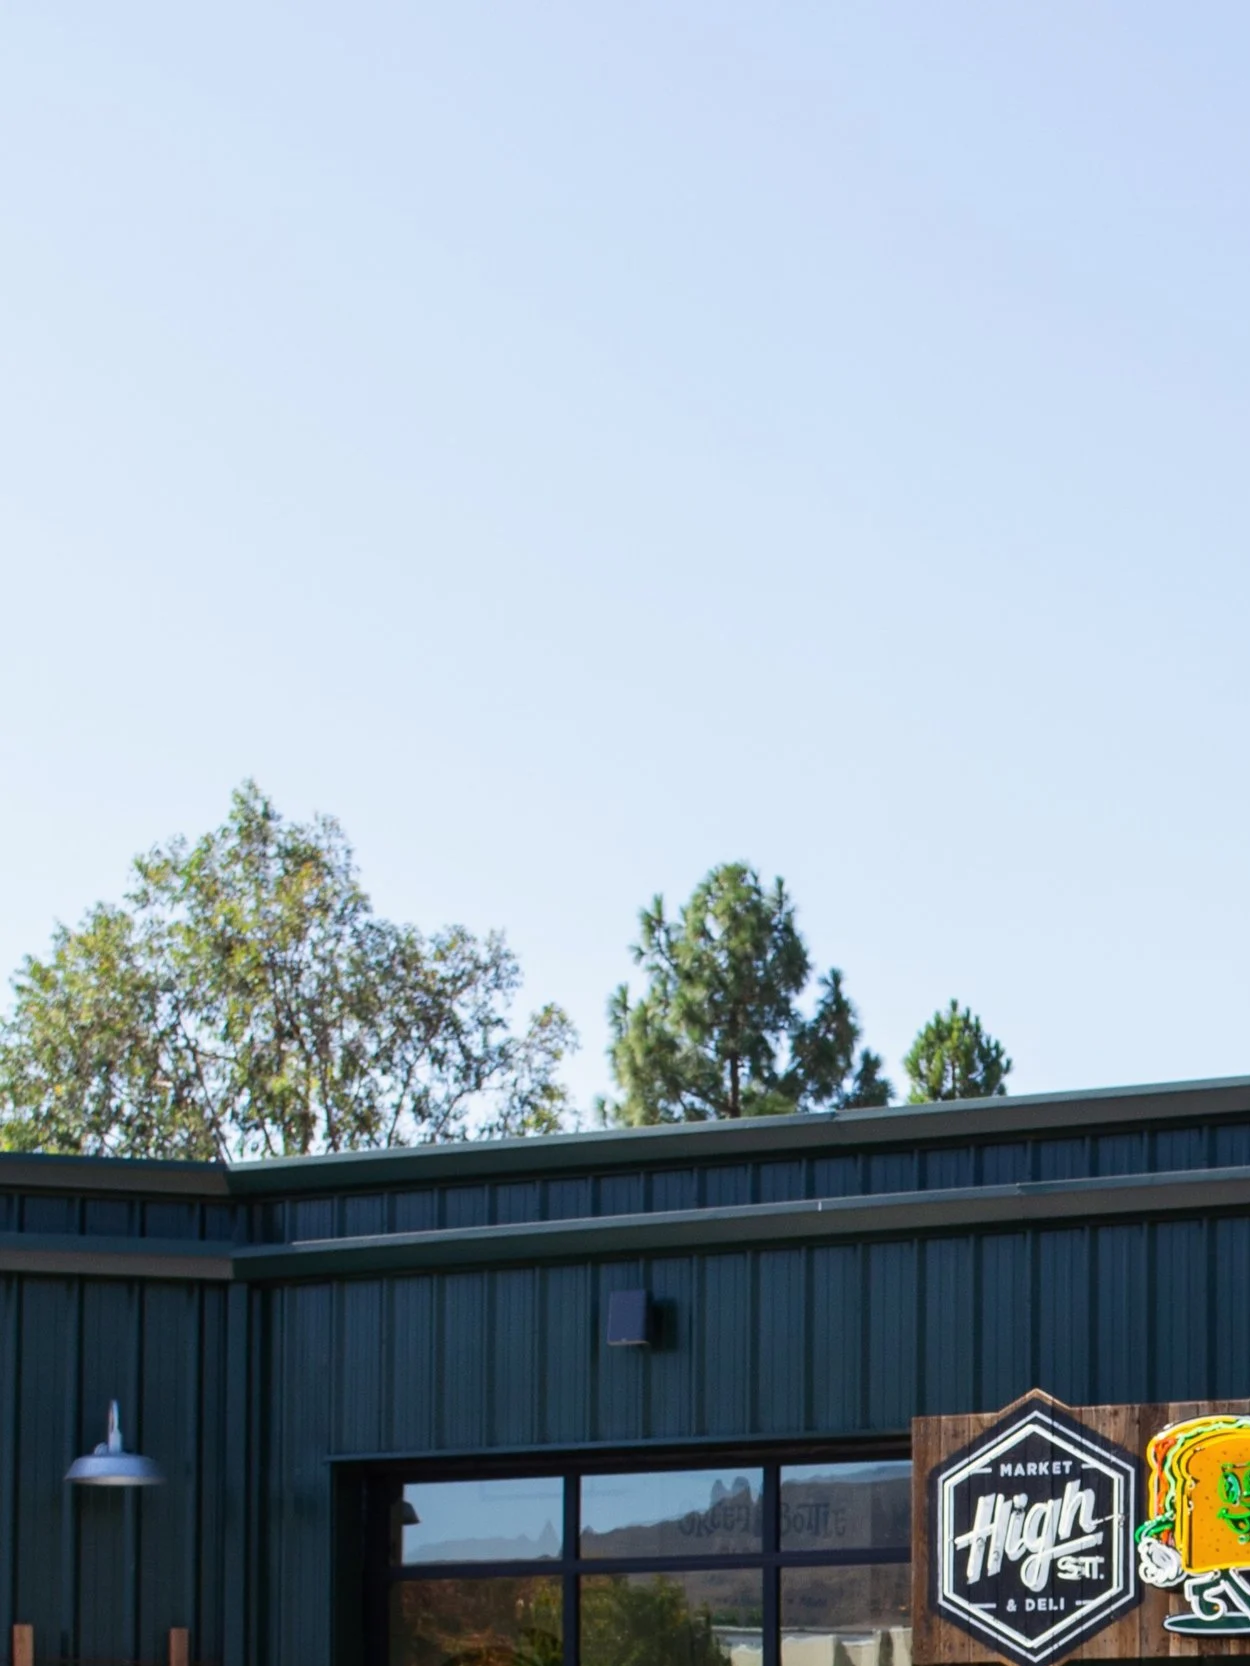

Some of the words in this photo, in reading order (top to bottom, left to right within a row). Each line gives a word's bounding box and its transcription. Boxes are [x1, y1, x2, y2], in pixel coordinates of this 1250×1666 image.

[1000, 1461, 1073, 1478] MARKET
[955, 1479, 1103, 1592] High
[1006, 1599, 1017, 1612] &
[1025, 1597, 1066, 1612] DELI
